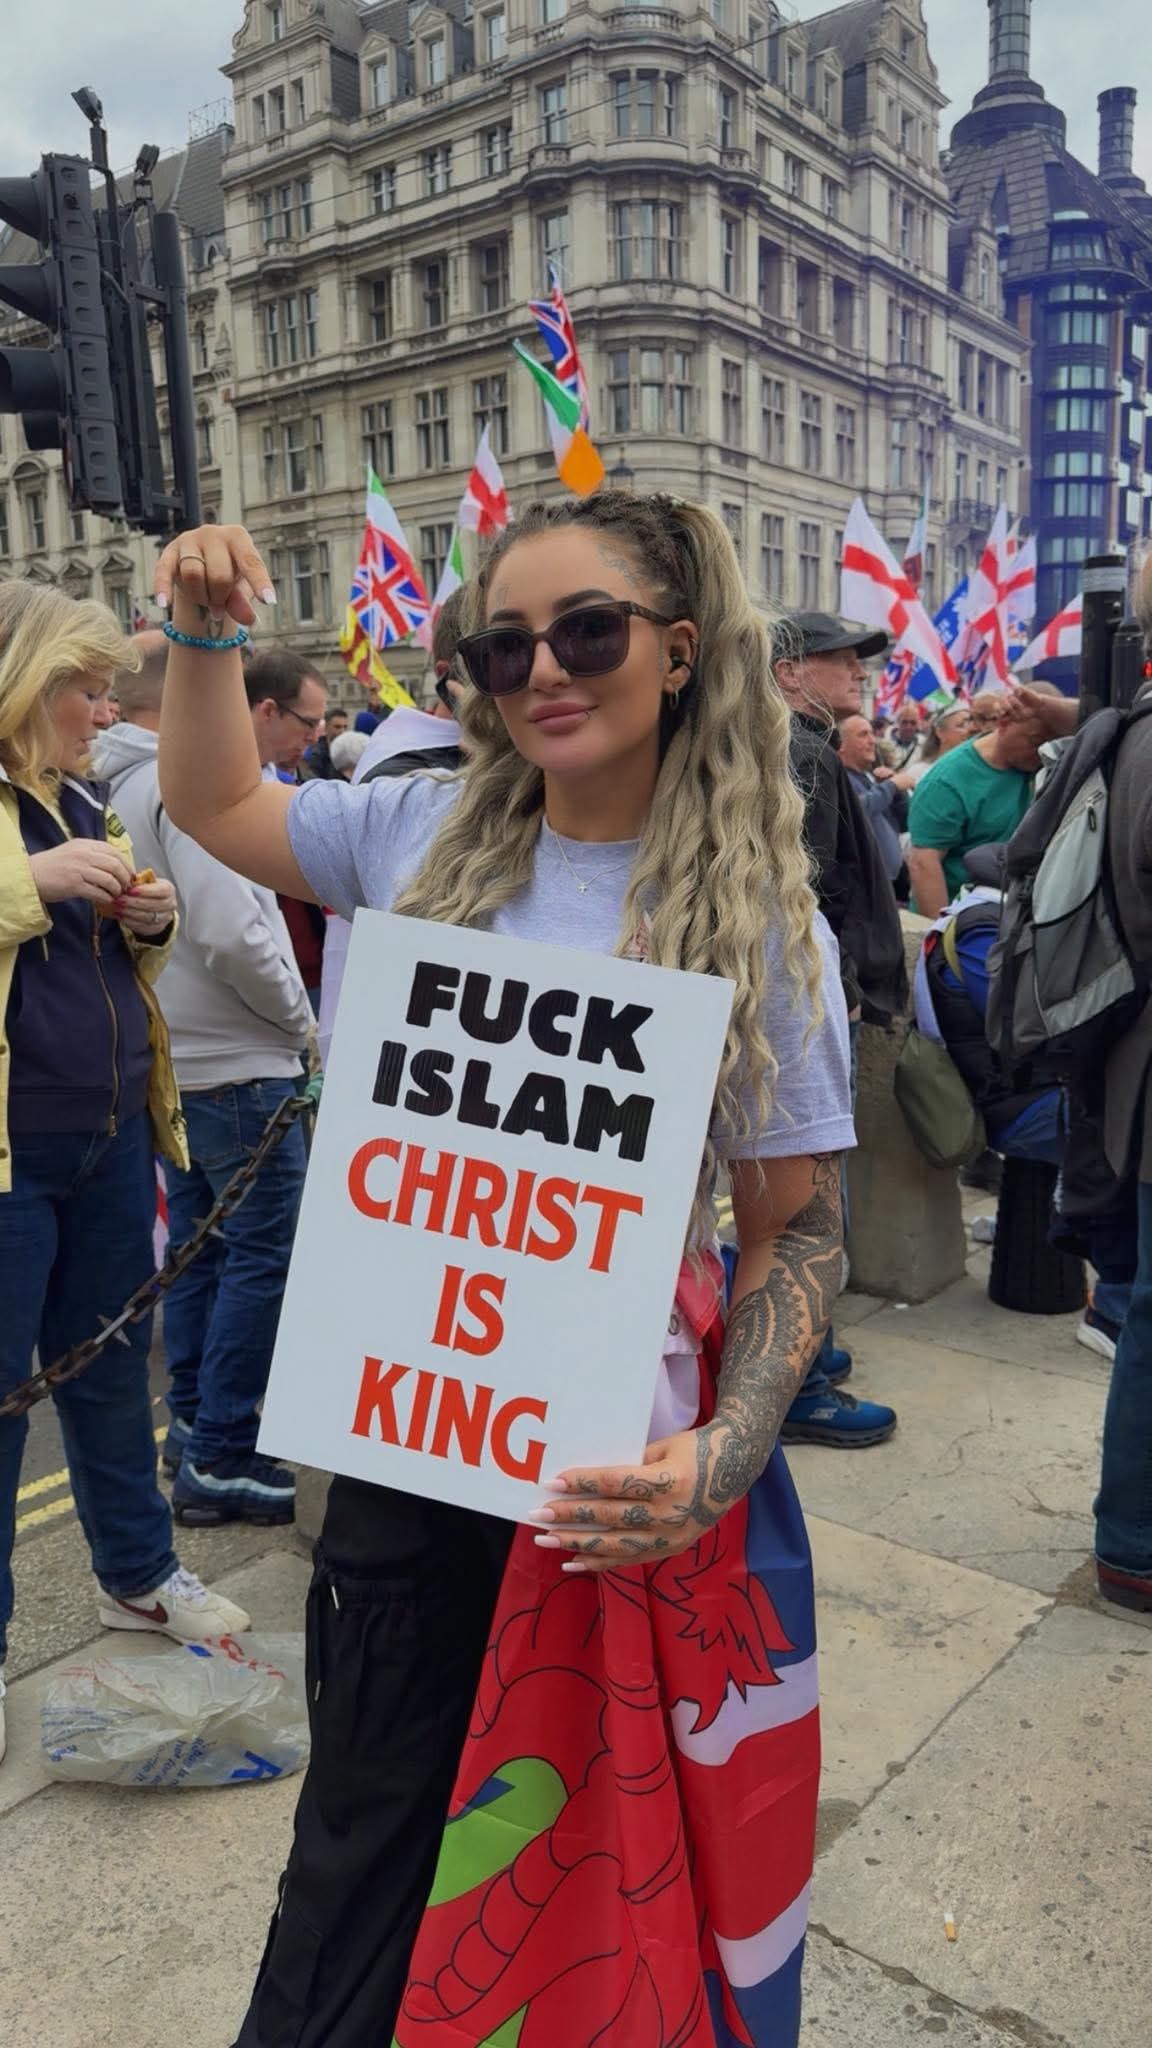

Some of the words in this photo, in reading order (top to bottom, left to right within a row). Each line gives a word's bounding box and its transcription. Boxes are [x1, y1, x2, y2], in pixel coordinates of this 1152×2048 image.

[405, 960, 654, 1074] FUCK
[371, 1040, 655, 1163] ISLAM
[347, 1137, 644, 1274] CHRIST
[431, 1264, 507, 1357] IS
[350, 1356, 549, 1484] KING
